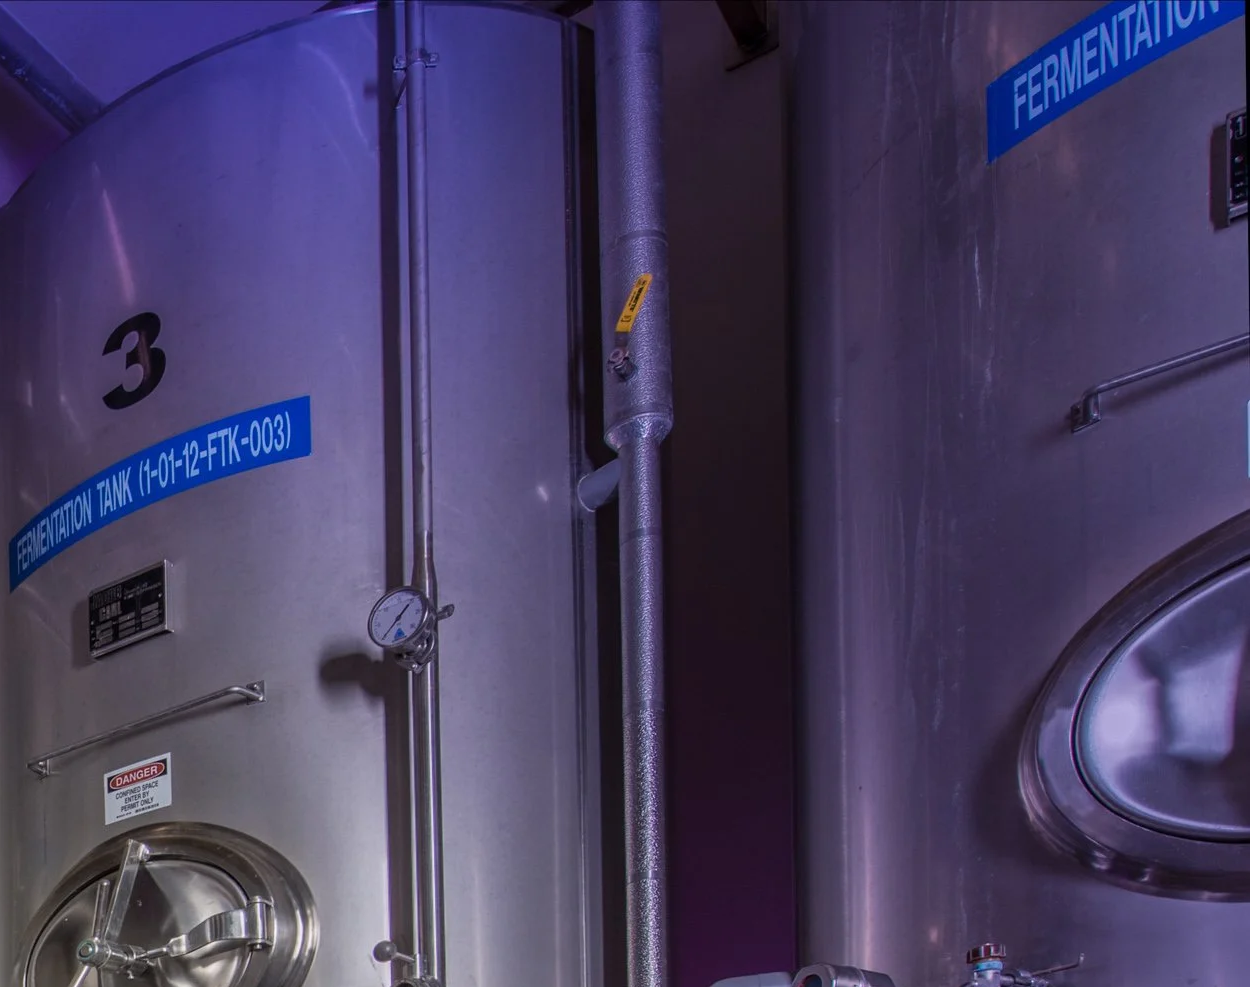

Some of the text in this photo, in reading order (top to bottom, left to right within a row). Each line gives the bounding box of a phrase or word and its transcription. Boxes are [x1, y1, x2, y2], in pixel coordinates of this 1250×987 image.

[102, 312, 166, 410] 3
[17, 411, 291, 574] FERMENTATION TANK (1-01-12-FTK-003)
[116, 765, 158, 786] DANGER
[115, 780, 159, 800] CONFINED SPACE
[124, 791, 150, 804] ENTER BY
[120, 801, 139, 812] PERMIT
[140, 797, 154, 806] ONLY
